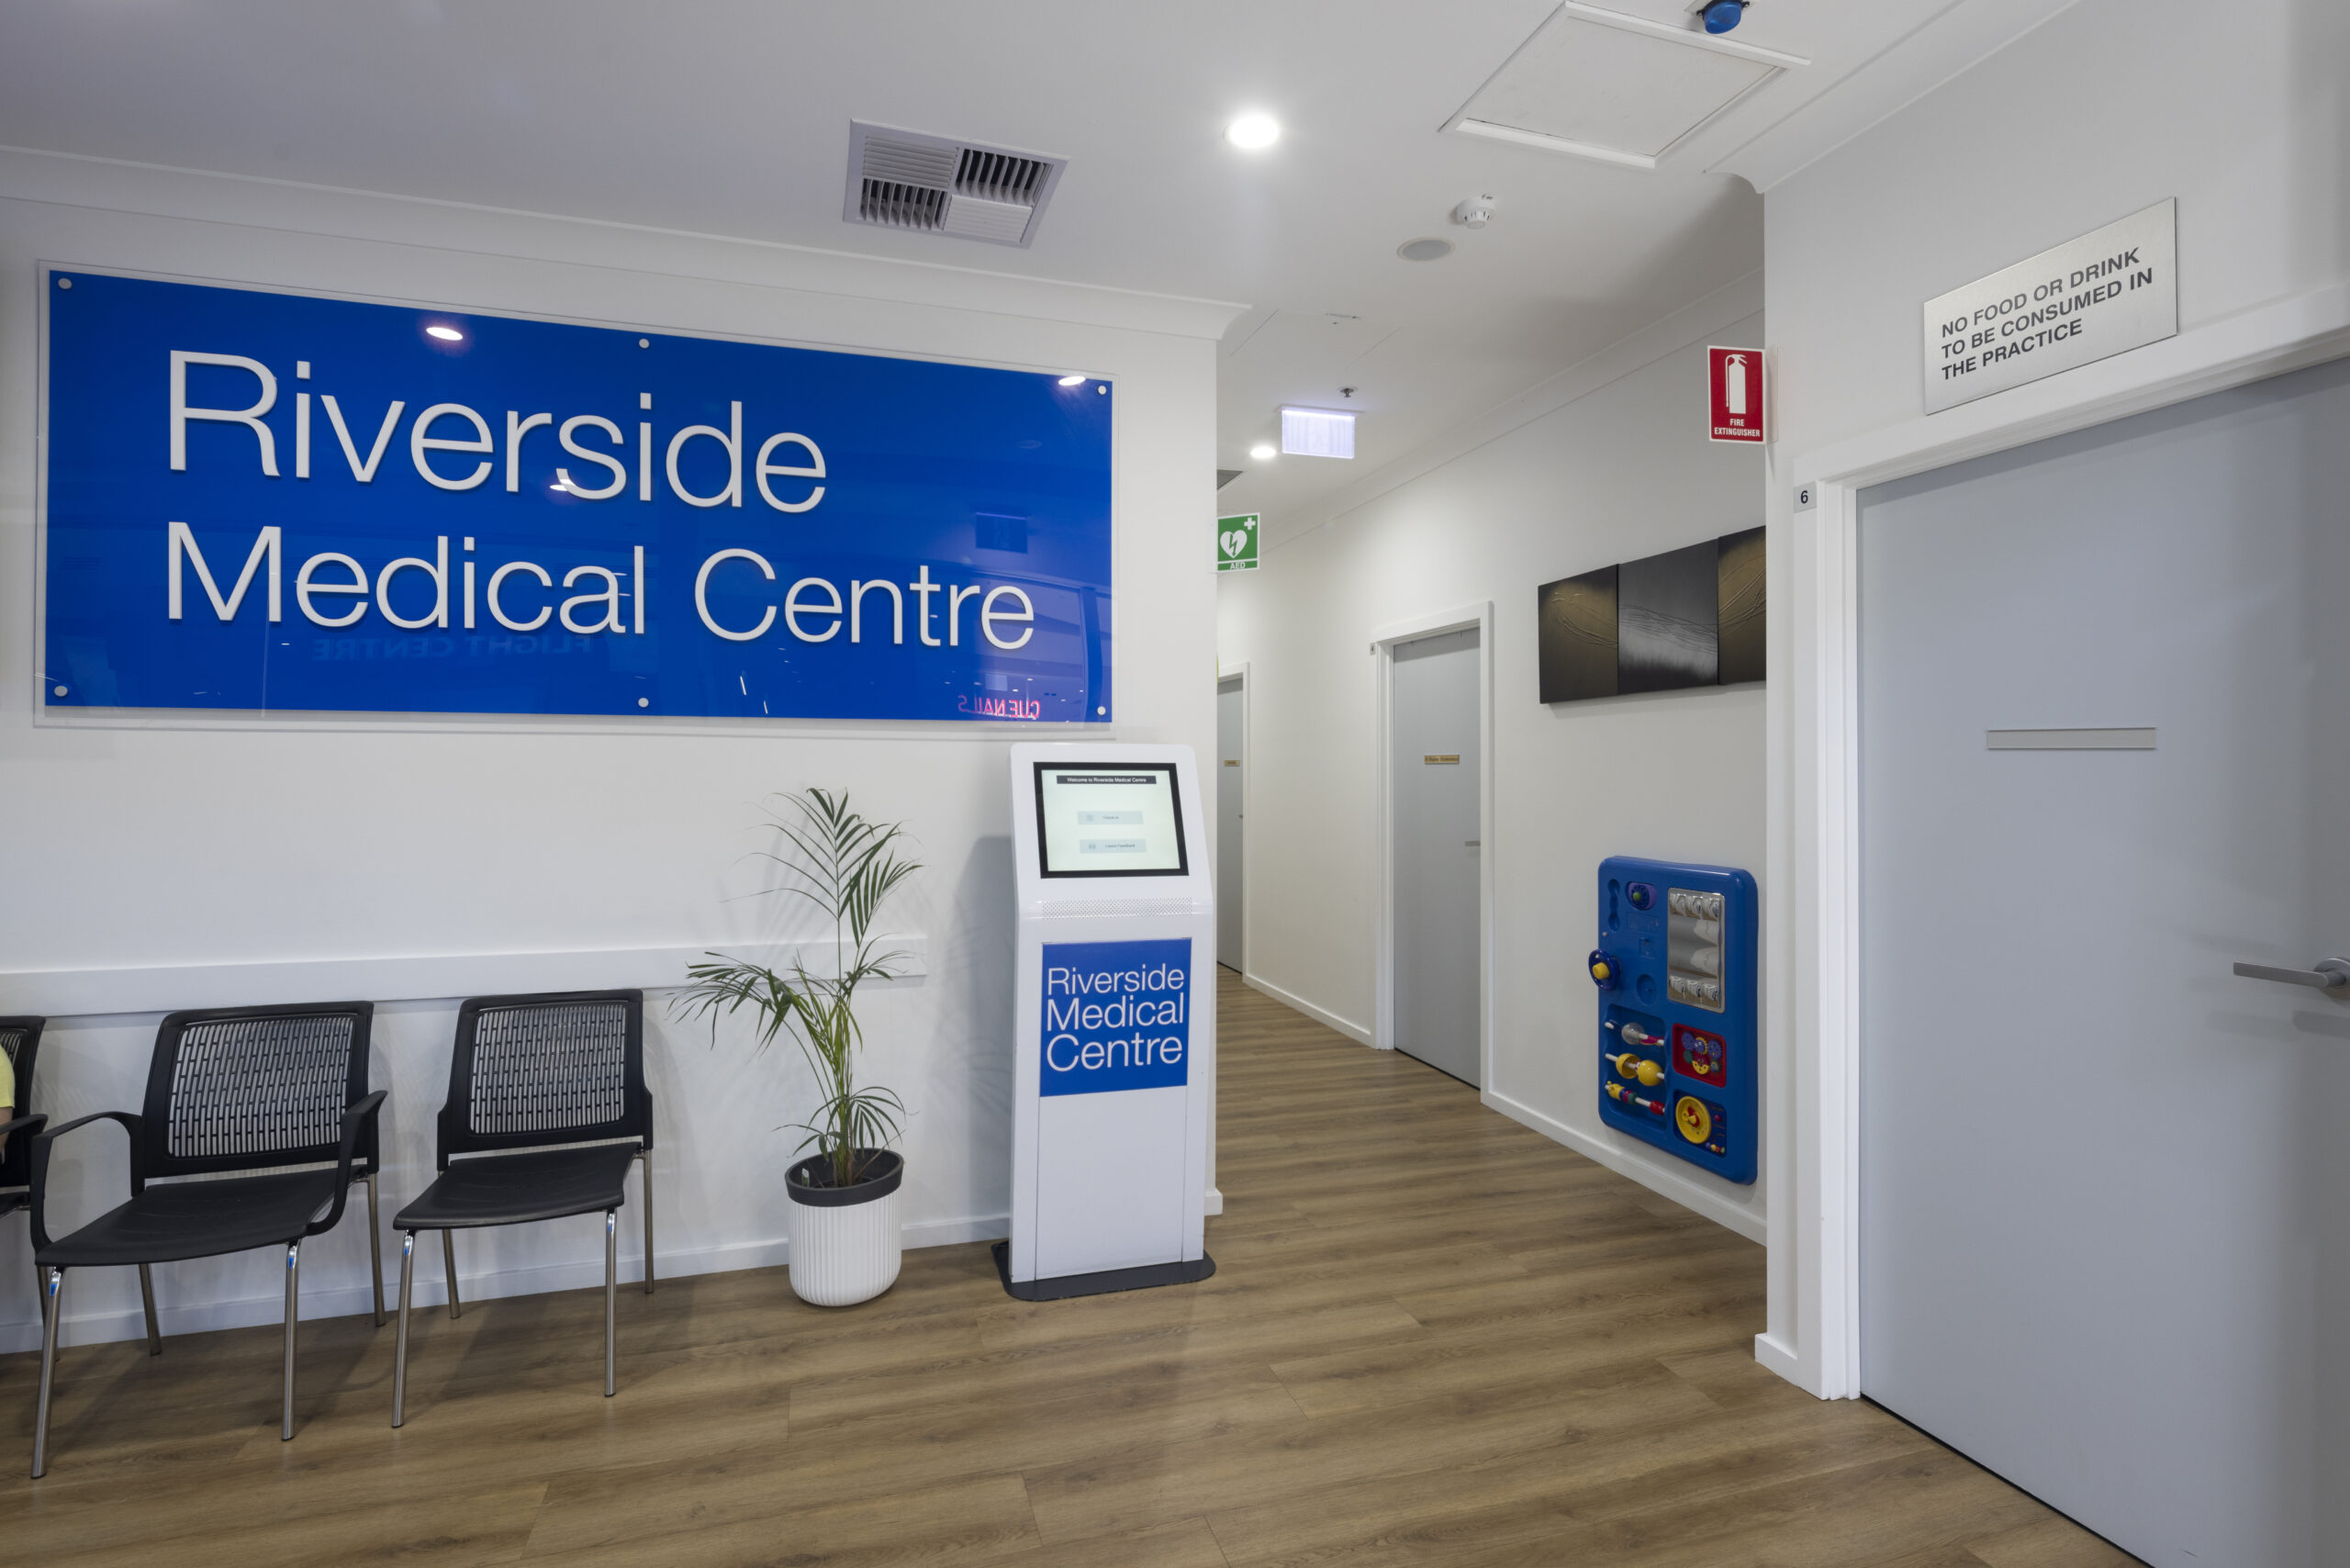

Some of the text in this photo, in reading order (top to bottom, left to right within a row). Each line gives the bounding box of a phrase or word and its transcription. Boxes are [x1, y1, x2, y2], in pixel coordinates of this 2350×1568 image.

[1942, 247, 2140, 338] NO FOOD OR DRINK
[1942, 267, 2153, 359] TO BE CONSUMED IN
[1942, 319, 2083, 380] THE PRACTICE
[169, 349, 826, 514] Riverside
[1714, 427, 1760, 437] EXTINGUISHER
[1800, 490, 1808, 504] 6
[167, 521, 1035, 650] Medical Centre
[1230, 561, 1246, 570] AED
[1047, 963, 1185, 996] Riverside
[1046, 992, 1184, 1032] Medical
[1046, 1032, 1182, 1072] Centre
